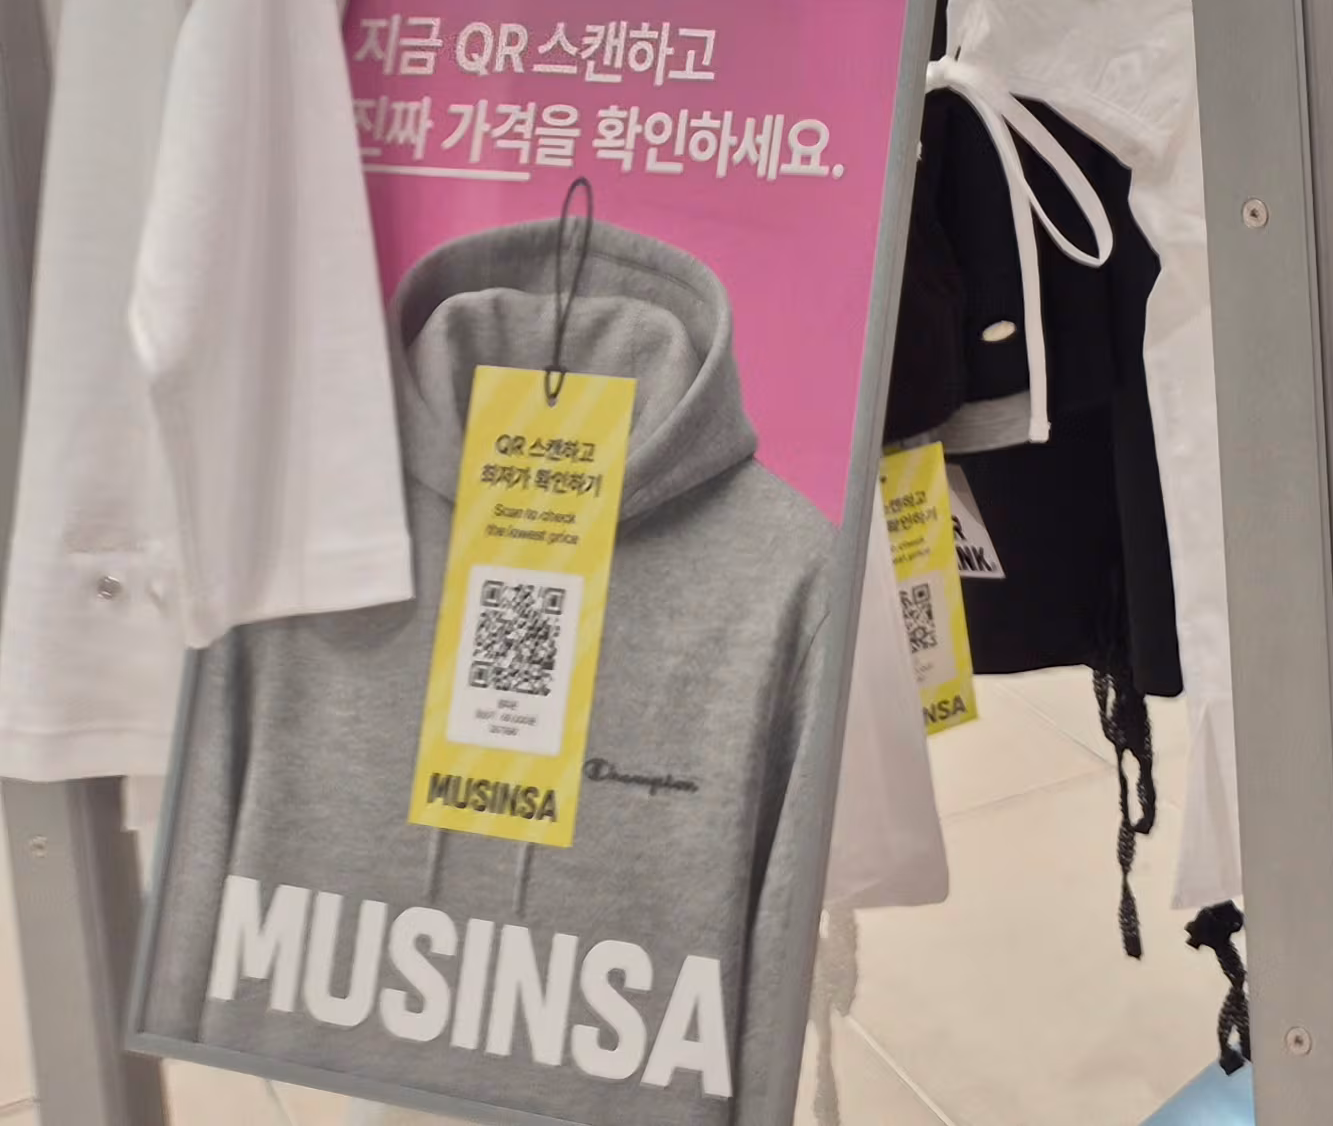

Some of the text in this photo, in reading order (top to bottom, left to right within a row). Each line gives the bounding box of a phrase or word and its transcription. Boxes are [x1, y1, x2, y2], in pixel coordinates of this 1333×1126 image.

[355, 13, 716, 86] 지금 QR 스캔하고
[352, 95, 845, 181] 진짜 가격을 확인하세요.
[495, 434, 596, 463] QR 스캔하고
[534, 468, 603, 498] 확인하기
[426, 772, 558, 823] MUSINSA
[207, 874, 734, 1099] MUSINSA
